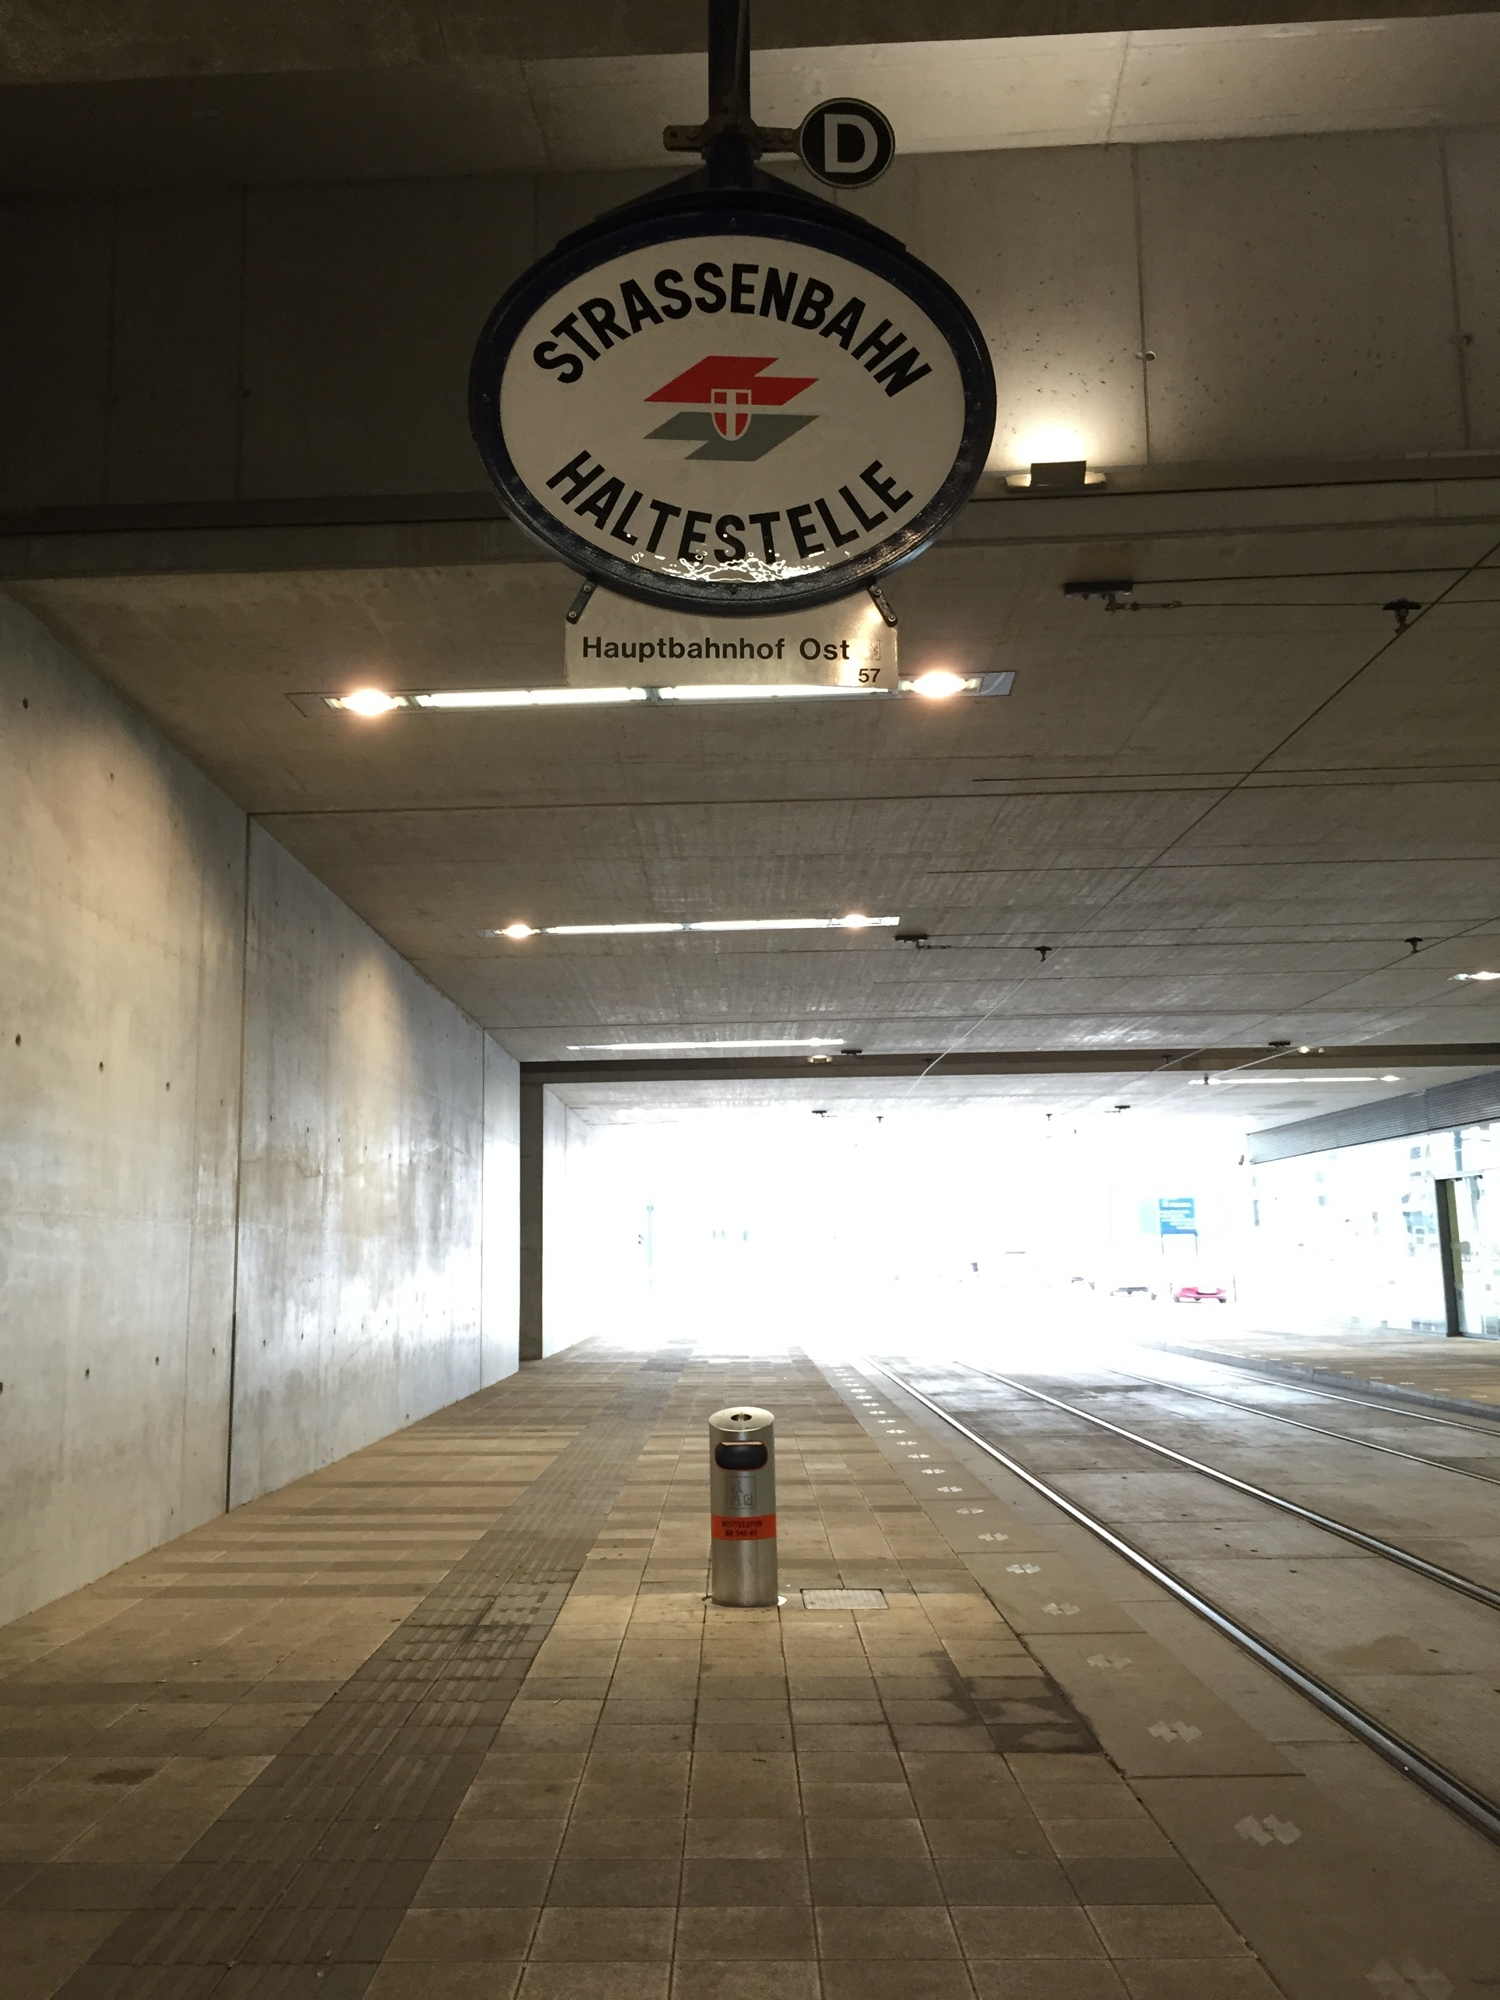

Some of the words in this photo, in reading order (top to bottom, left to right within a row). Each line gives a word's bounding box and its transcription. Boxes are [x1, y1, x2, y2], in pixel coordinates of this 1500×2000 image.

[824, 113, 879, 174] D
[532, 262, 932, 398] STRASSENBAHN
[545, 450, 914, 566] HALTESTELLE
[582, 636, 785, 662] Hauptbahnhof
[799, 637, 850, 660] Ost
[858, 667, 881, 683] 57
